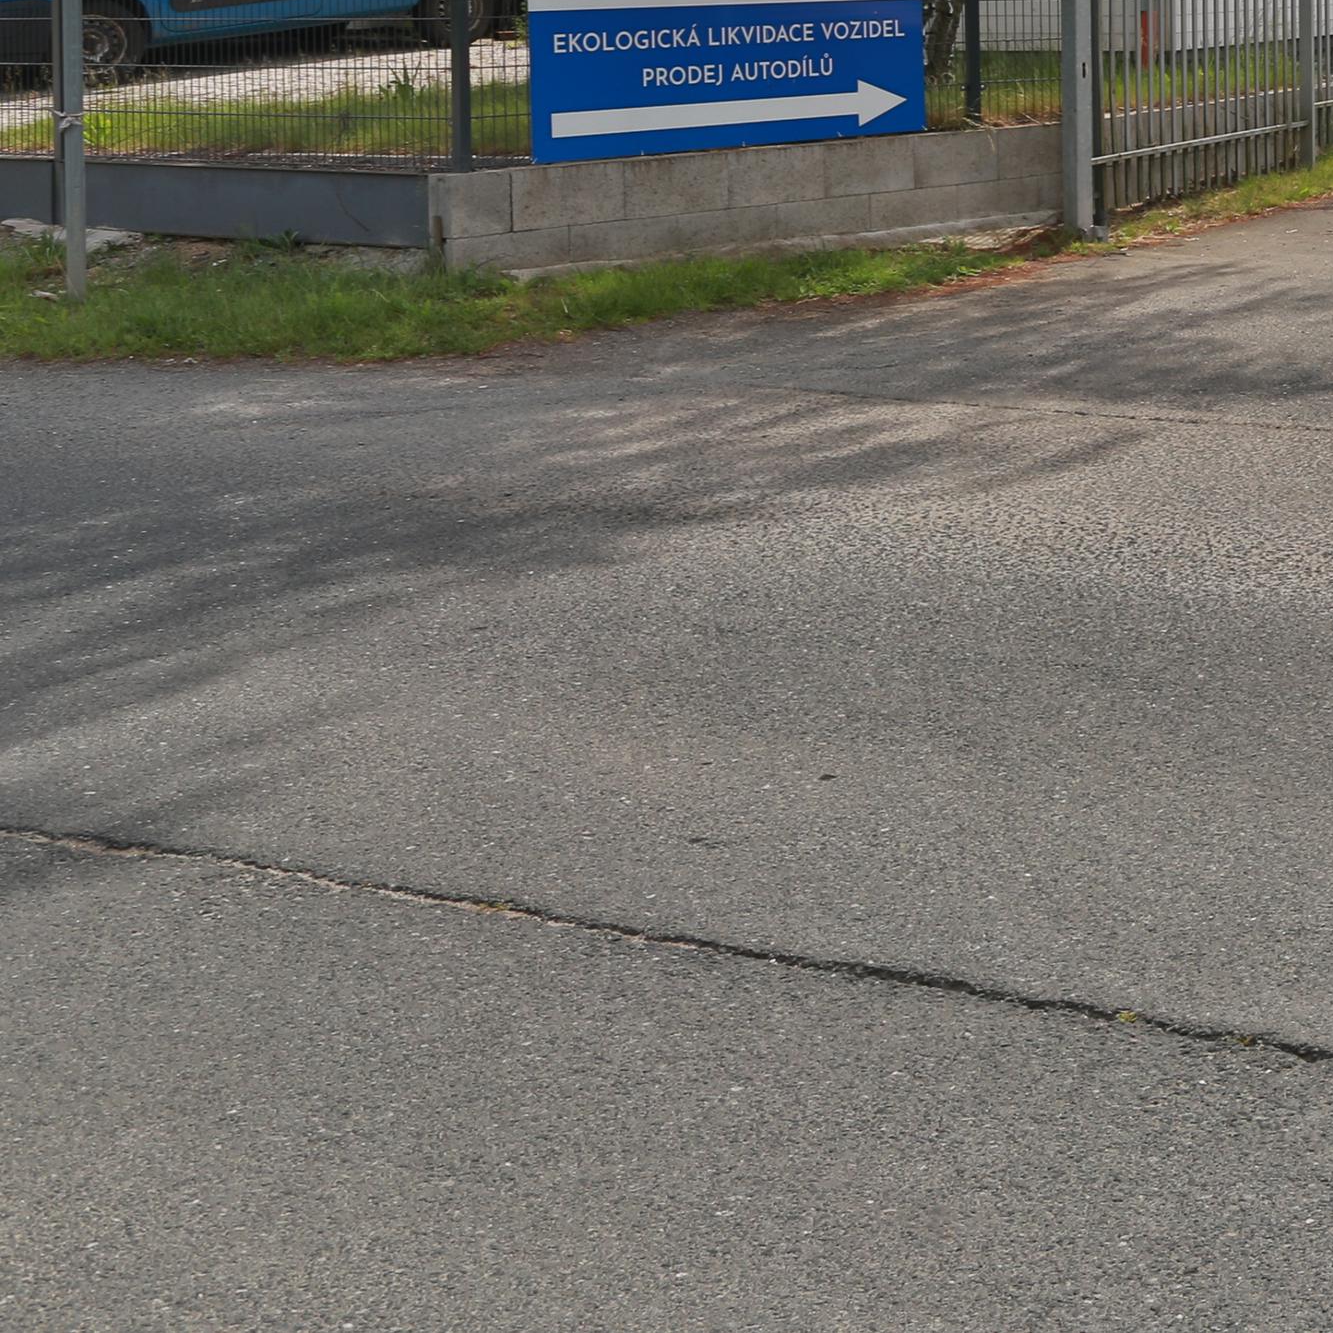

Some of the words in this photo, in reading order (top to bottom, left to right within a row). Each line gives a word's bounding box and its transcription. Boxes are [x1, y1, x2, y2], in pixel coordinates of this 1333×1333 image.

[553, 24, 701, 54] EKOLOGICKÁ
[708, 23, 814, 46] LIKVIDACE
[821, 19, 904, 40] VOZIDEL
[642, 64, 723, 87] PRODEJ
[731, 53, 833, 81] AUTODÍLŮ
